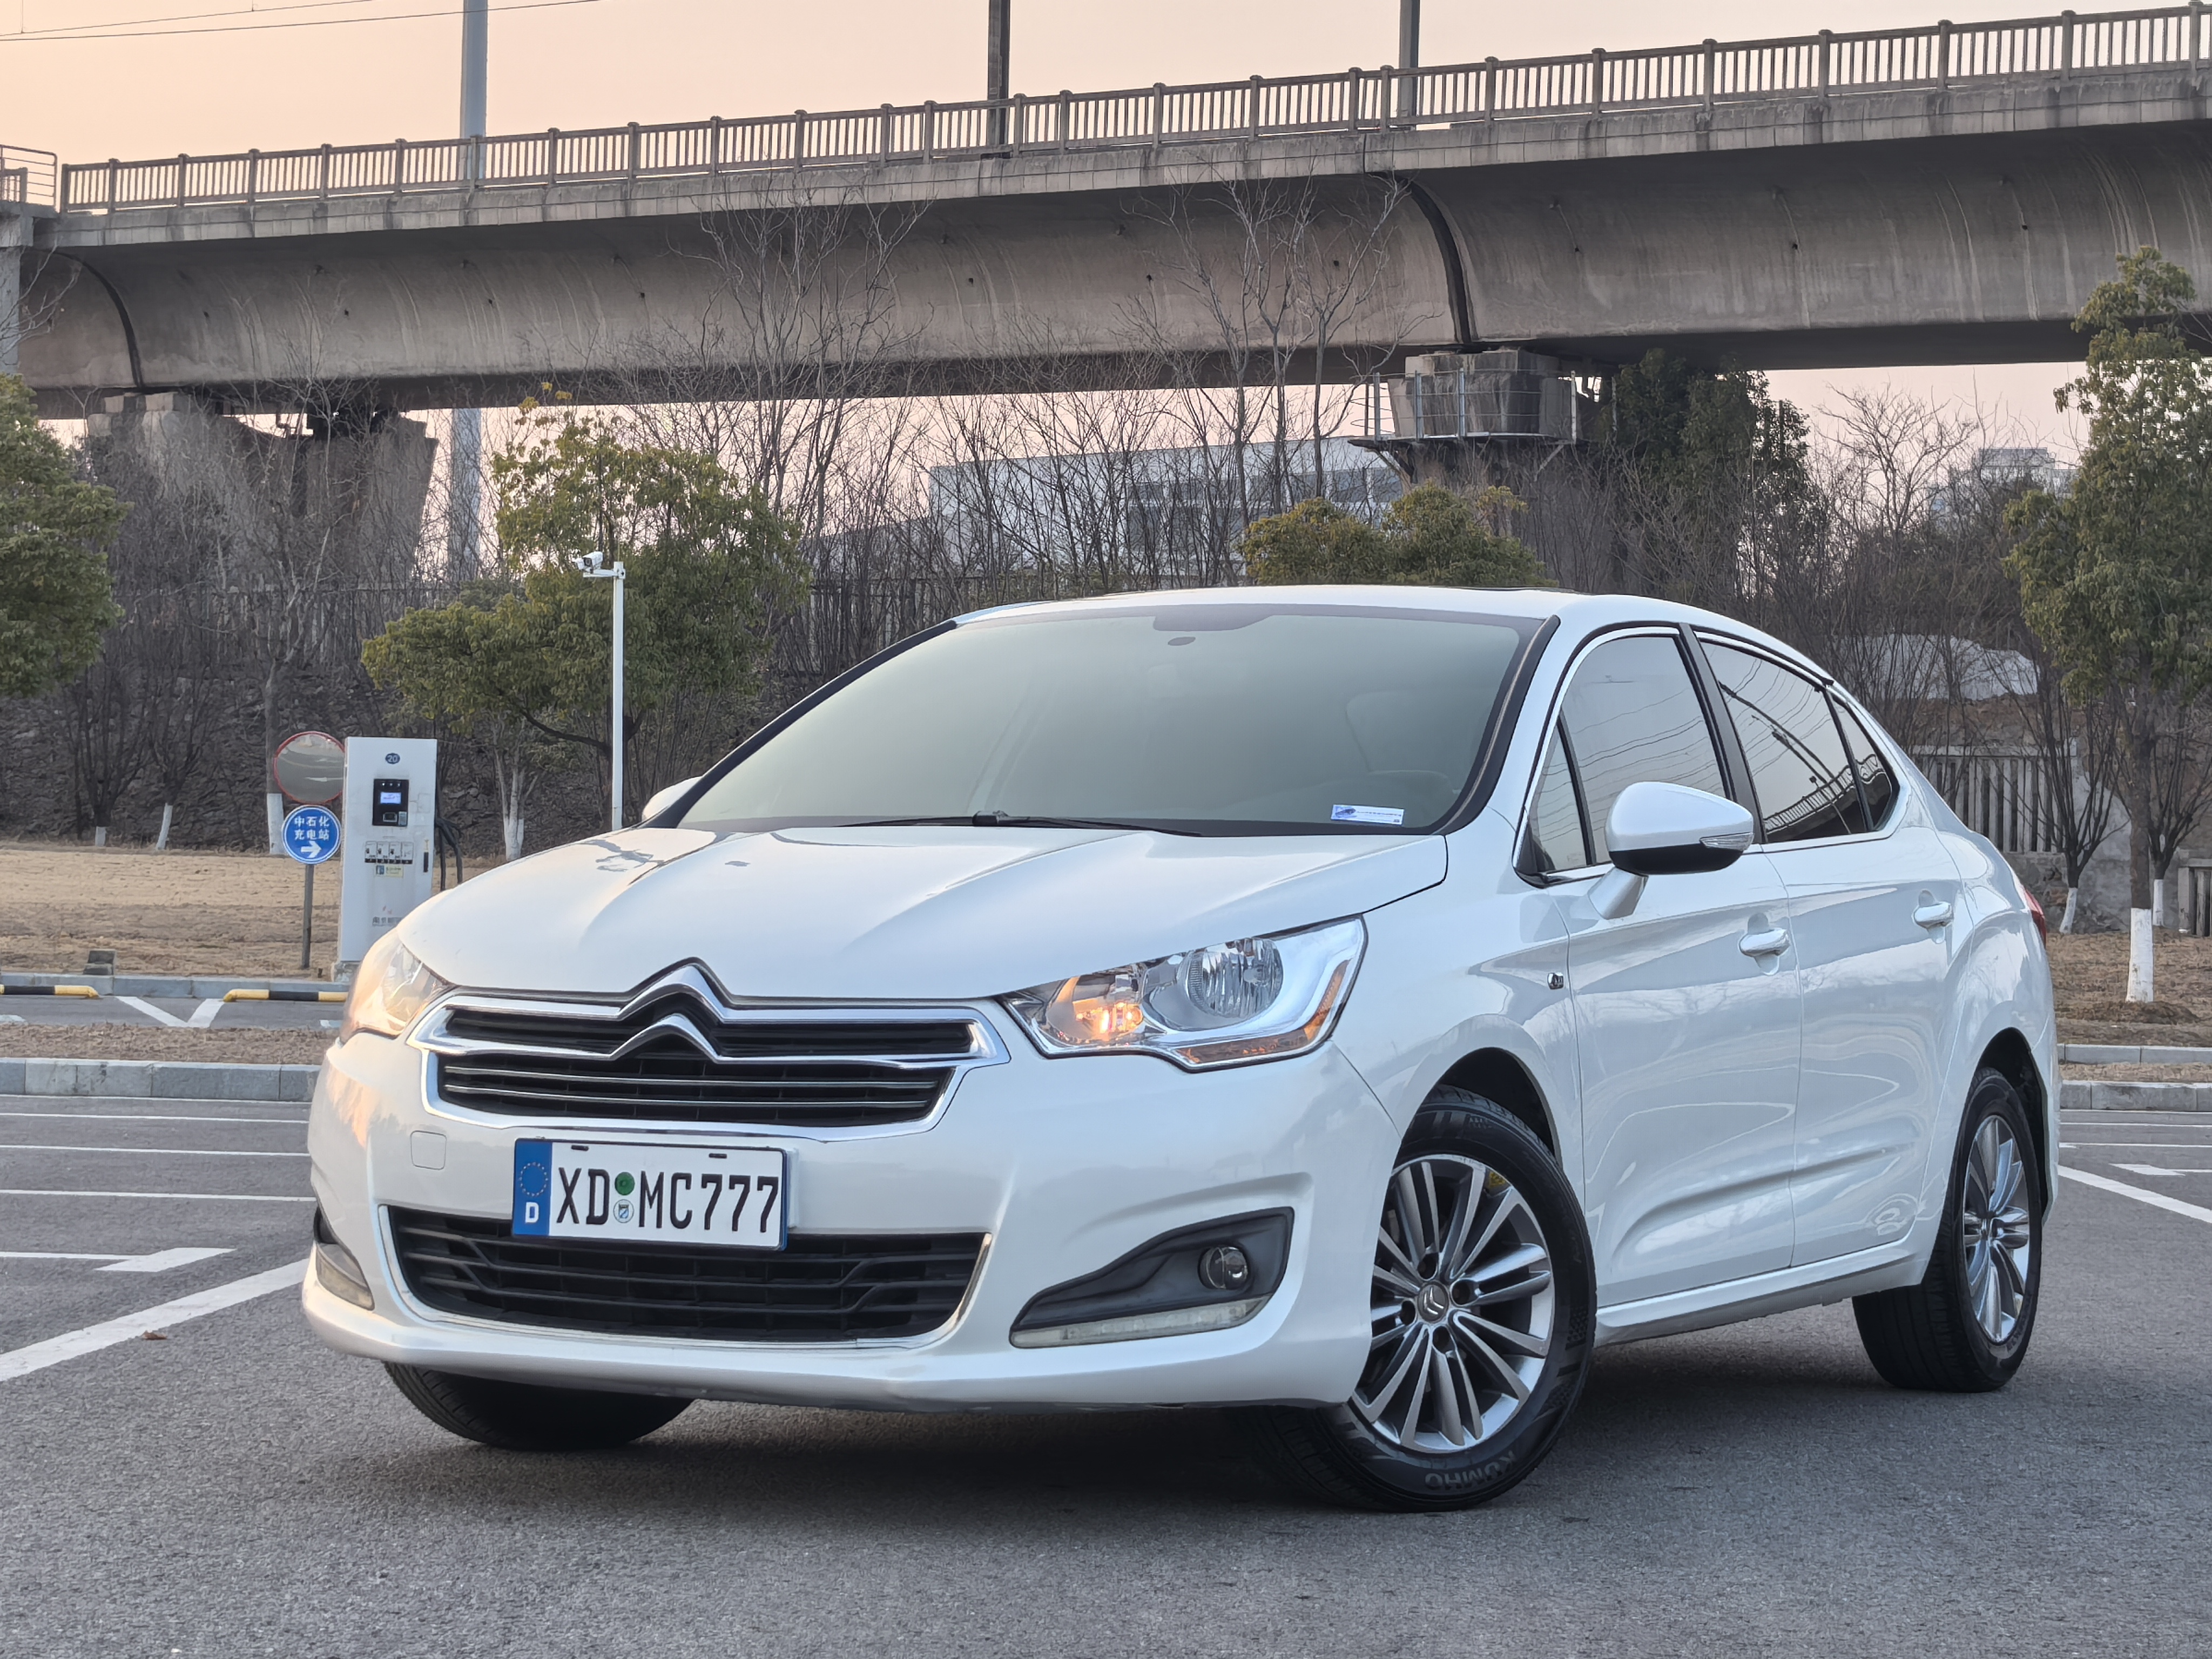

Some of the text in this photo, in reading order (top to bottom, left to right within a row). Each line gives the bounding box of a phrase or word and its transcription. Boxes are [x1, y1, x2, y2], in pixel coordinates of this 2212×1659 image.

[388, 754, 398, 763] 20
[294, 815, 329, 827] 中石化
[294, 828, 329, 841] 充电站
[556, 1166, 611, 1225] XD
[524, 1202, 539, 1224] D
[1425, 1449, 1517, 1491] KUMHO
